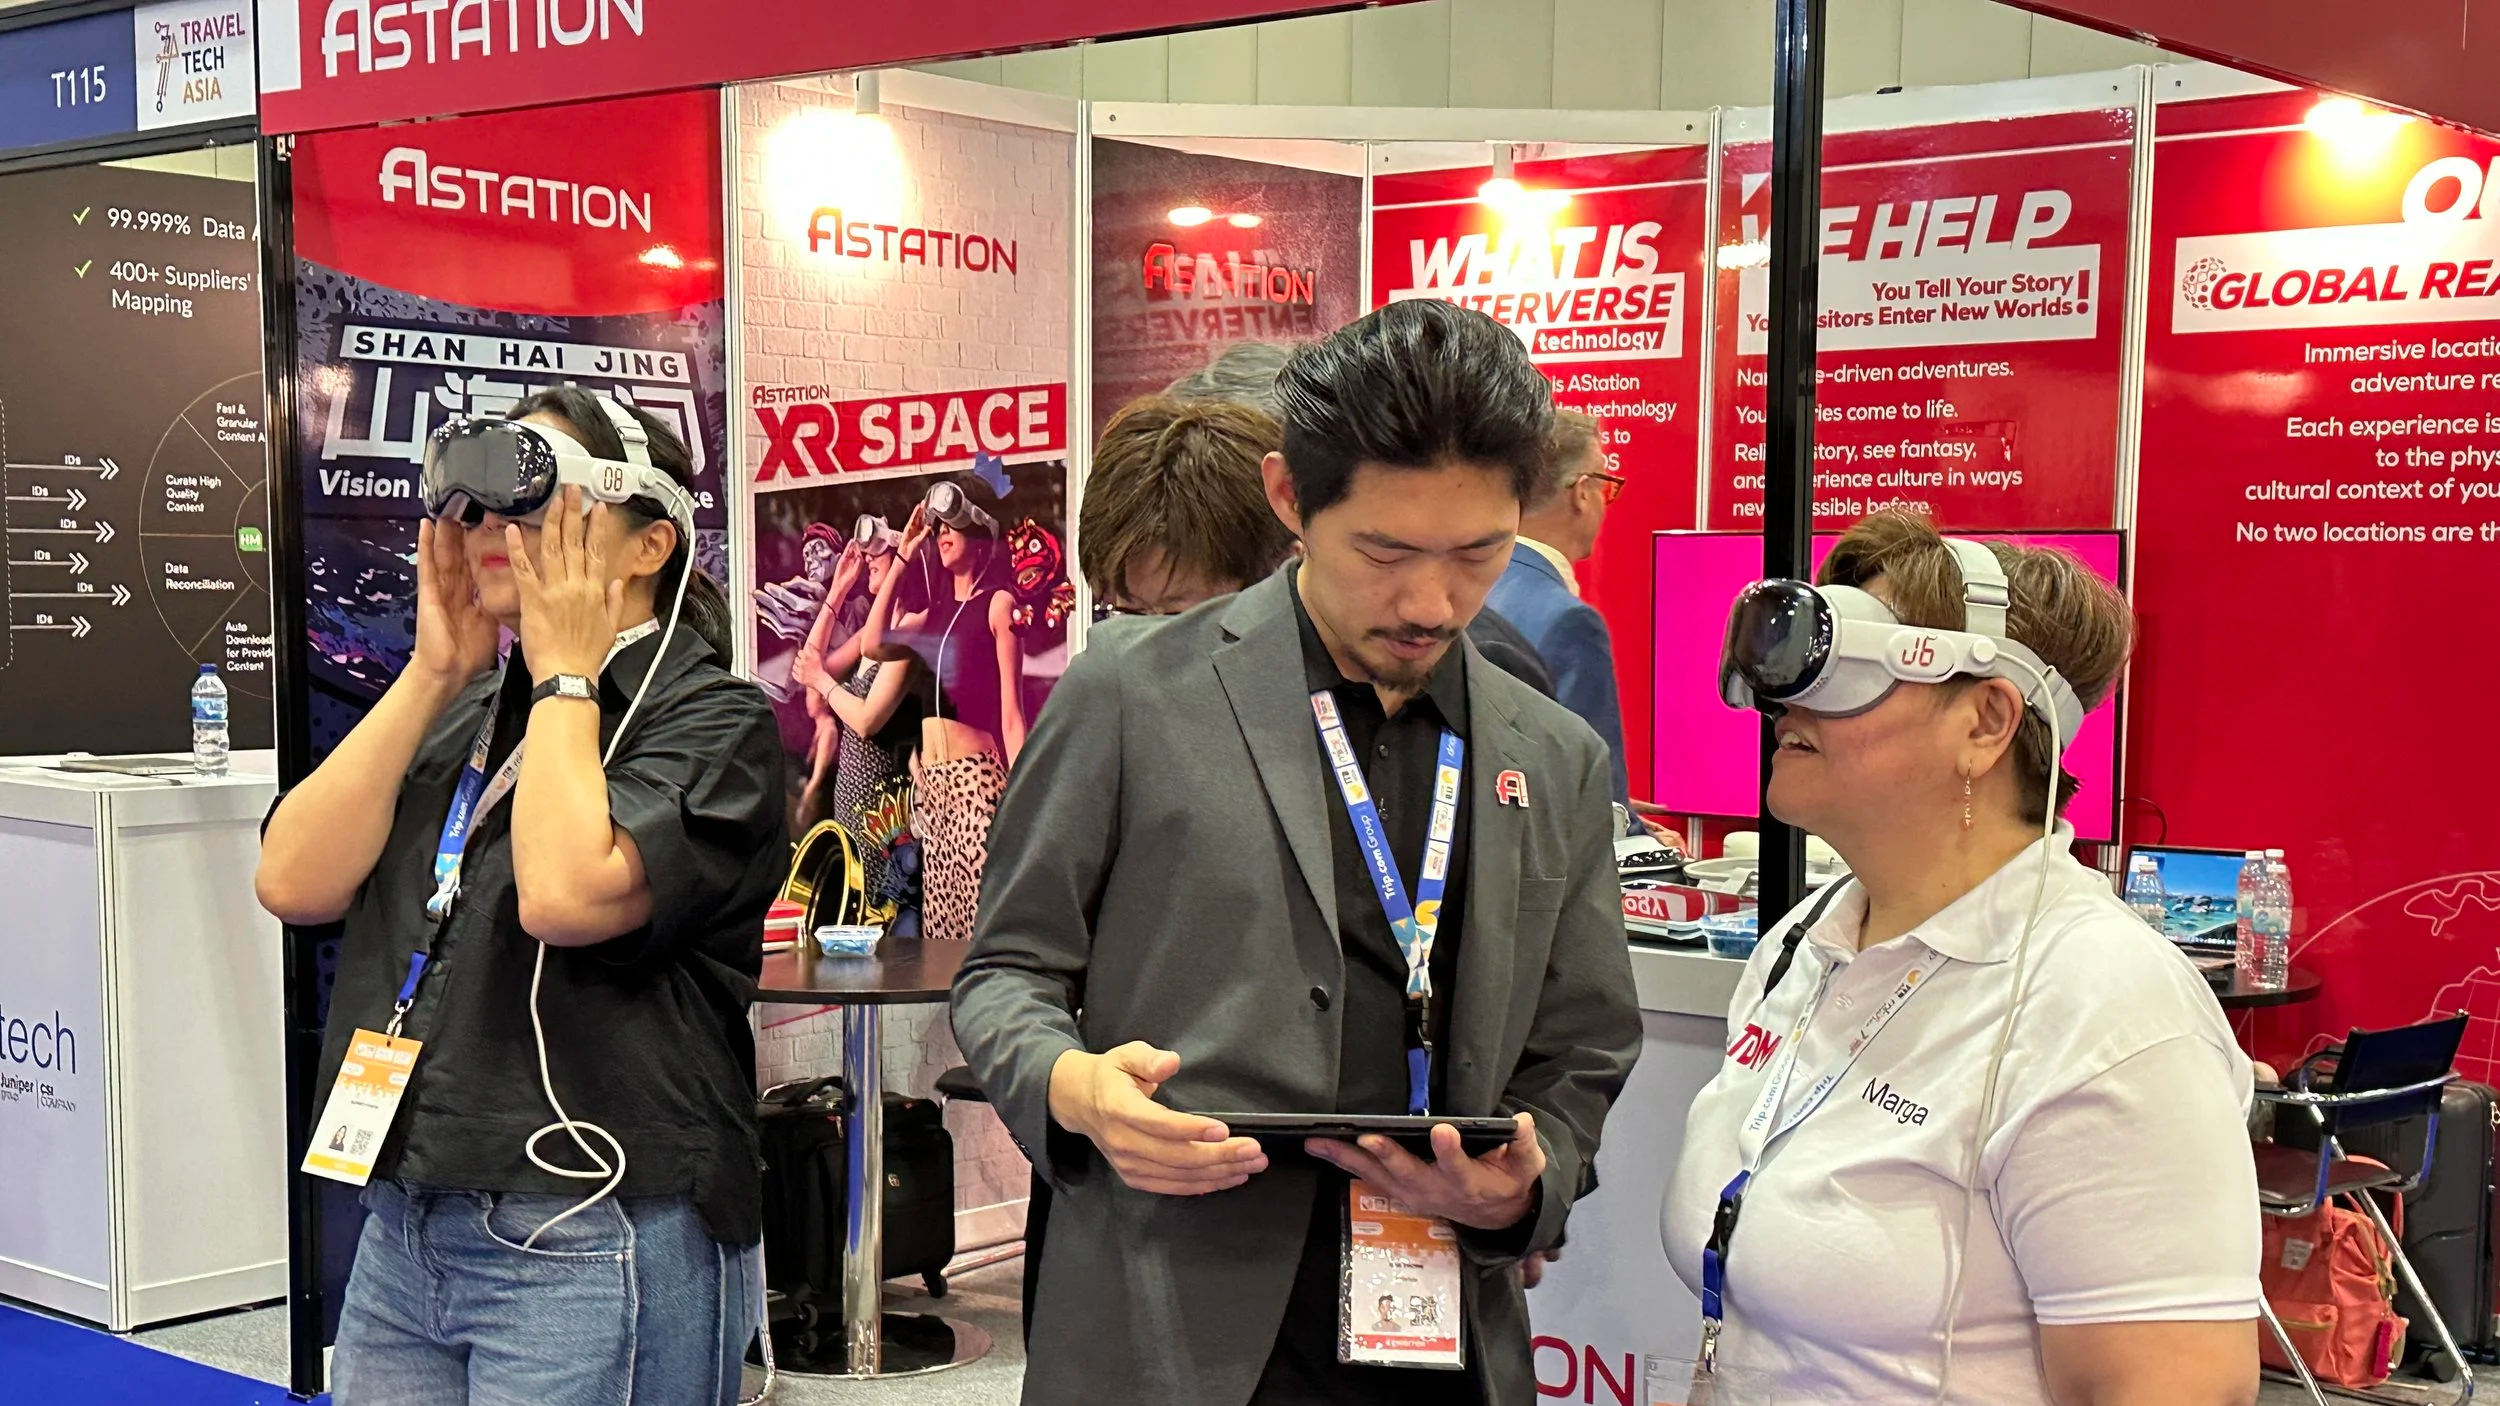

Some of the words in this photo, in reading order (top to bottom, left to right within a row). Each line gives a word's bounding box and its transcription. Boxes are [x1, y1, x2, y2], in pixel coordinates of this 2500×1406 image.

[181, 12, 246, 45] TRAVEL
[182, 46, 224, 74] TECH
[51, 65, 106, 108] T115
[183, 77, 222, 104] ASIA
[380, 146, 651, 233] ASTATION
[107, 207, 191, 236] 99.999%
[203, 217, 246, 240] Data
[1865, 190, 2072, 260] HELP
[808, 206, 1017, 276] ASTATION
[1410, 225, 1597, 290] WHAT
[1601, 221, 1663, 280] IS
[110, 261, 159, 282] 400+
[165, 265, 250, 292] Suppliers'
[1872, 282, 1910, 301] You
[1916, 278, 1950, 298] Tell
[1956, 277, 2007, 297] Your
[2012, 273, 2074, 296] Story
[2210, 265, 2408, 310] GLOBAL
[112, 288, 193, 318] Mapping
[1879, 306, 1936, 325] Enter
[1941, 302, 1989, 322] New
[1994, 297, 2073, 319] Worlds
[1538, 328, 1660, 352] technology
[2304, 339, 2426, 363] Immersive
[354, 331, 466, 362] SHAN
[500, 343, 564, 369] HAI
[594, 351, 679, 377] JING
[1567, 373, 1640, 392] AStation
[1898, 361, 2014, 382] adventures.
[2351, 371, 2475, 393] adventure
[753, 384, 830, 405] ASTATION
[1586, 399, 1677, 423] technology
[1735, 406, 1767, 424] You
[1846, 404, 1896, 421] come
[1902, 401, 1921, 420] to
[1926, 399, 1959, 419] life.
[754, 402, 840, 482] XR
[859, 390, 1050, 464] SPACE
[1614, 428, 1631, 444] to
[2287, 415, 2344, 438] Each
[2349, 414, 2479, 441] experience
[65, 454, 81, 465] IDs
[1863, 444, 1896, 459] see
[1900, 439, 1977, 462] fantasy,
[2376, 448, 2400, 467] to
[2405, 446, 2445, 467] the
[31, 486, 48, 496] IDs
[319, 470, 410, 498] Vision
[1877, 467, 1943, 487] culture
[1948, 467, 1965, 486] in
[1970, 470, 2023, 491] ways
[2245, 479, 2331, 501] cultural
[2336, 480, 2423, 500] context
[2429, 477, 2455, 498] of
[60, 519, 77, 529] IDs
[2236, 522, 2268, 543] No
[2273, 523, 2318, 541] two
[2323, 519, 2427, 543] locations
[2432, 525, 2474, 542] are
[34, 550, 51, 560] IDs
[77, 582, 94, 592] IDs
[36, 614, 53, 624] IDs
[1861, 1077, 1929, 1126] Marga
